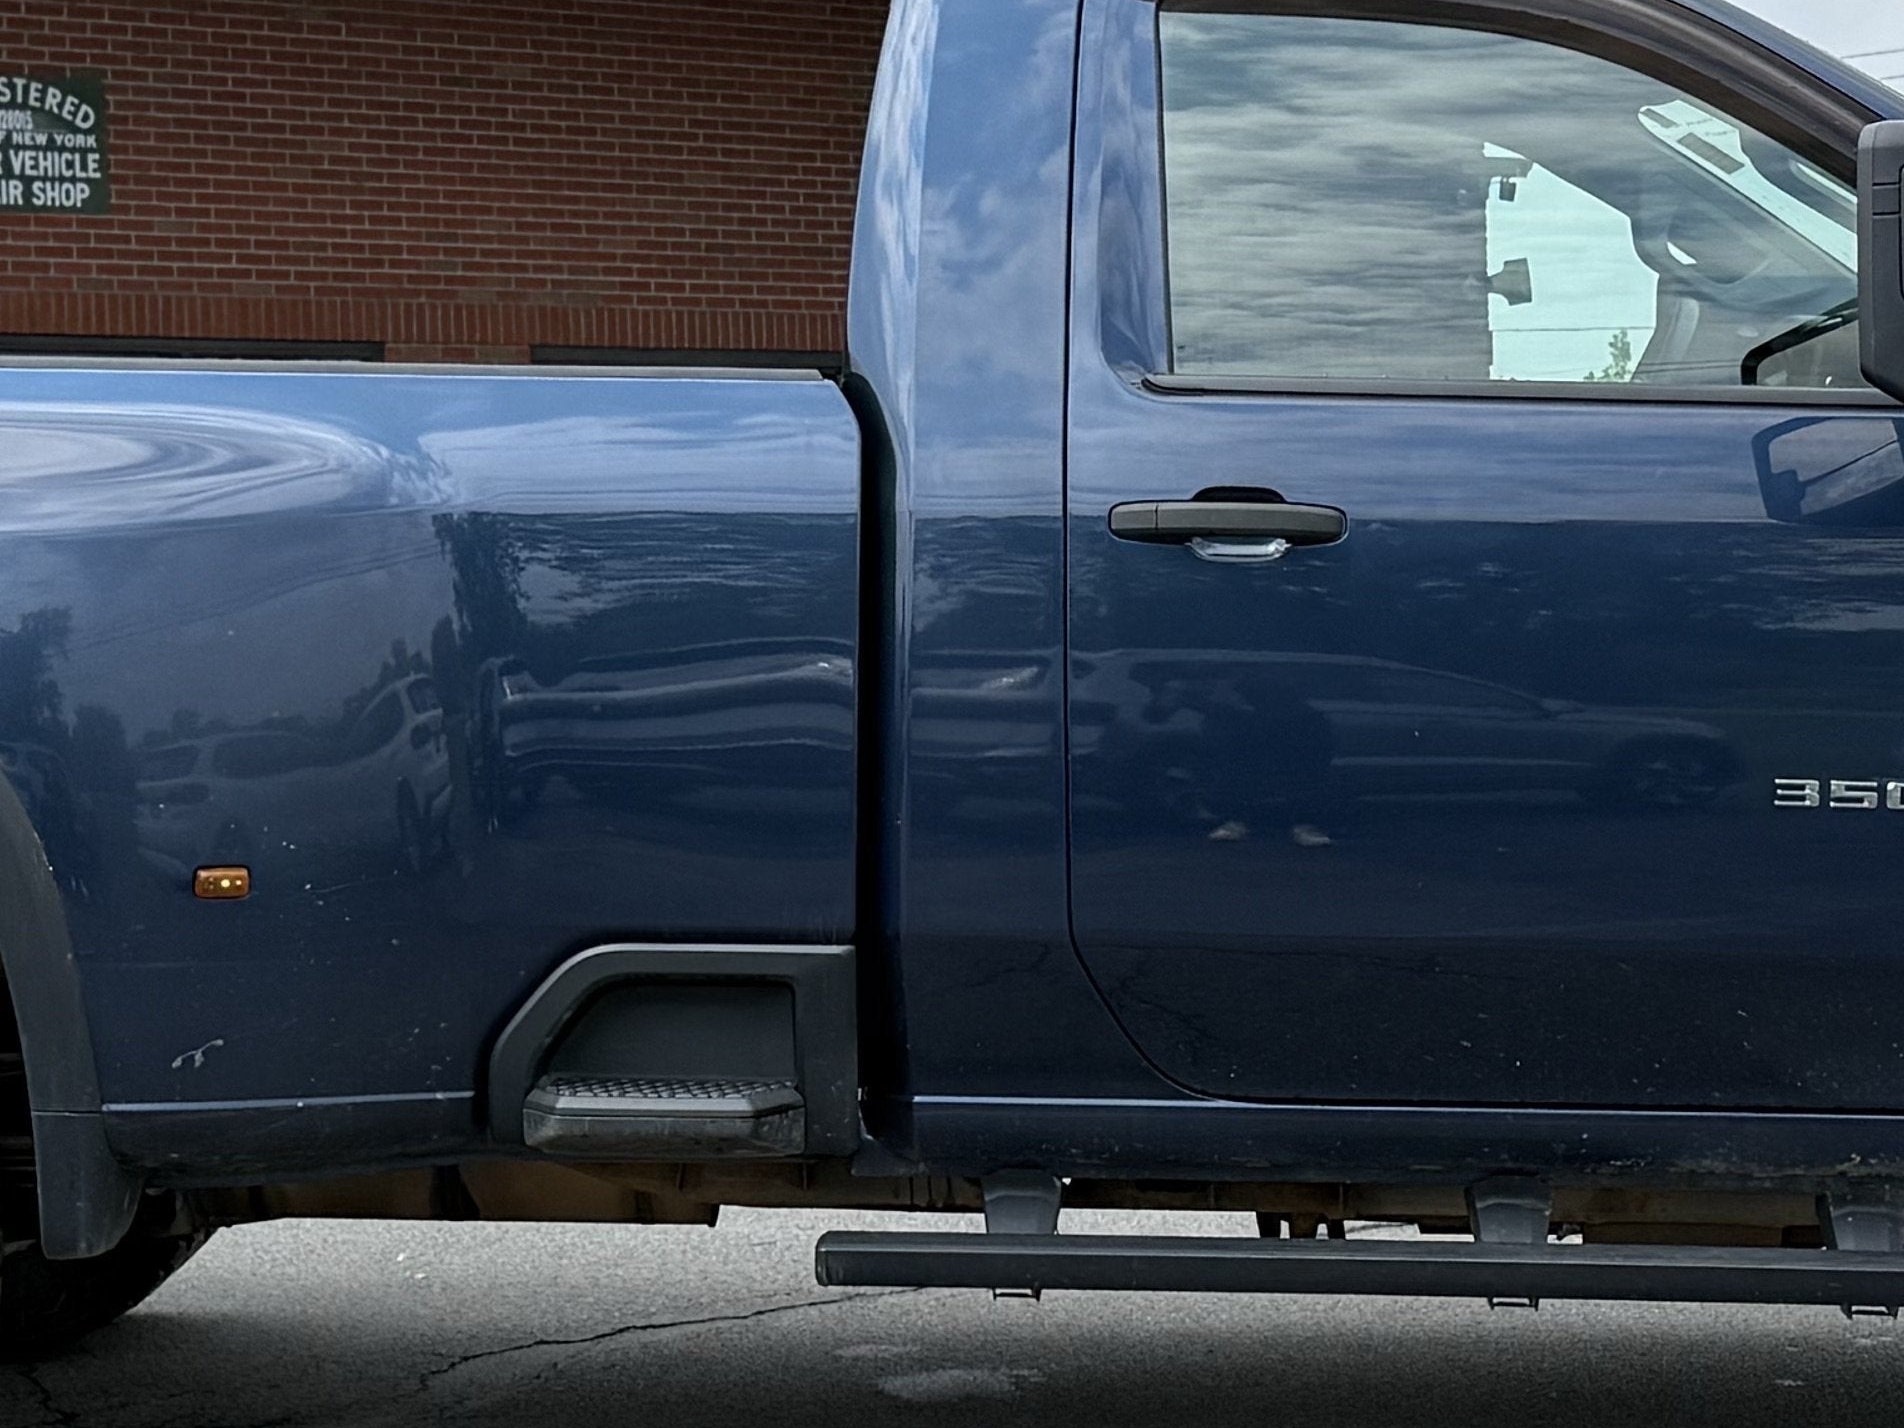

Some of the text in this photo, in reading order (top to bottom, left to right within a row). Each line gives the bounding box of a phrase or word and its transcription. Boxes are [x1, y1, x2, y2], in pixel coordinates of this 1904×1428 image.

[12, 131, 48, 146] NEW
[53, 133, 97, 149] YORK
[8, 149, 102, 179] VEHICLE
[31, 180, 91, 208] SHOP
